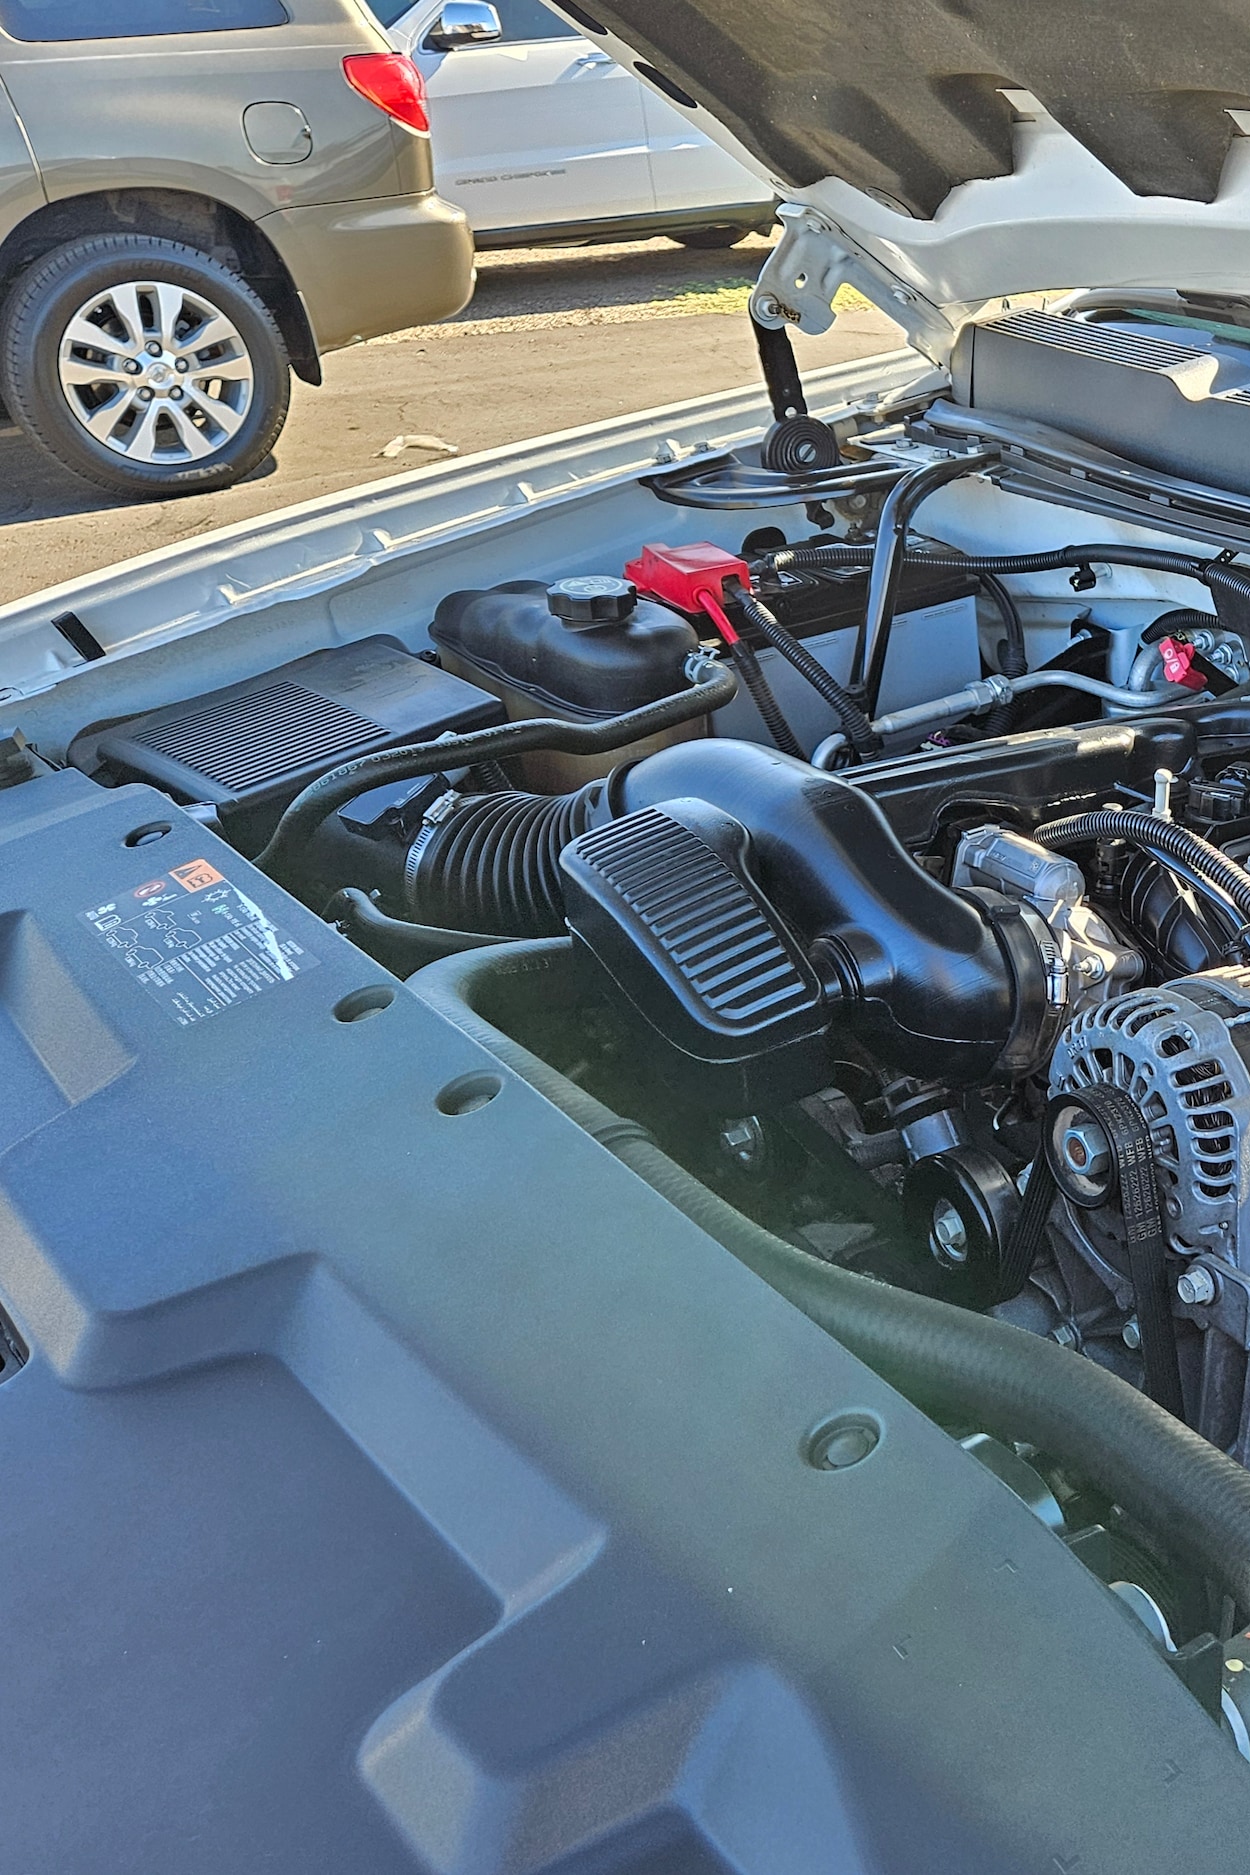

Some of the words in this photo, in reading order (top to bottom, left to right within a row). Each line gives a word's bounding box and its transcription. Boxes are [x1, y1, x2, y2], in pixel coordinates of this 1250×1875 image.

[1103, 1100, 1130, 1136] 6PK2370
[1129, 1169, 1144, 1218] 12626222
[1140, 1166, 1153, 1215] 12626222
[1136, 1221, 1148, 1241] GM
[1146, 1217, 1158, 1238] GM
